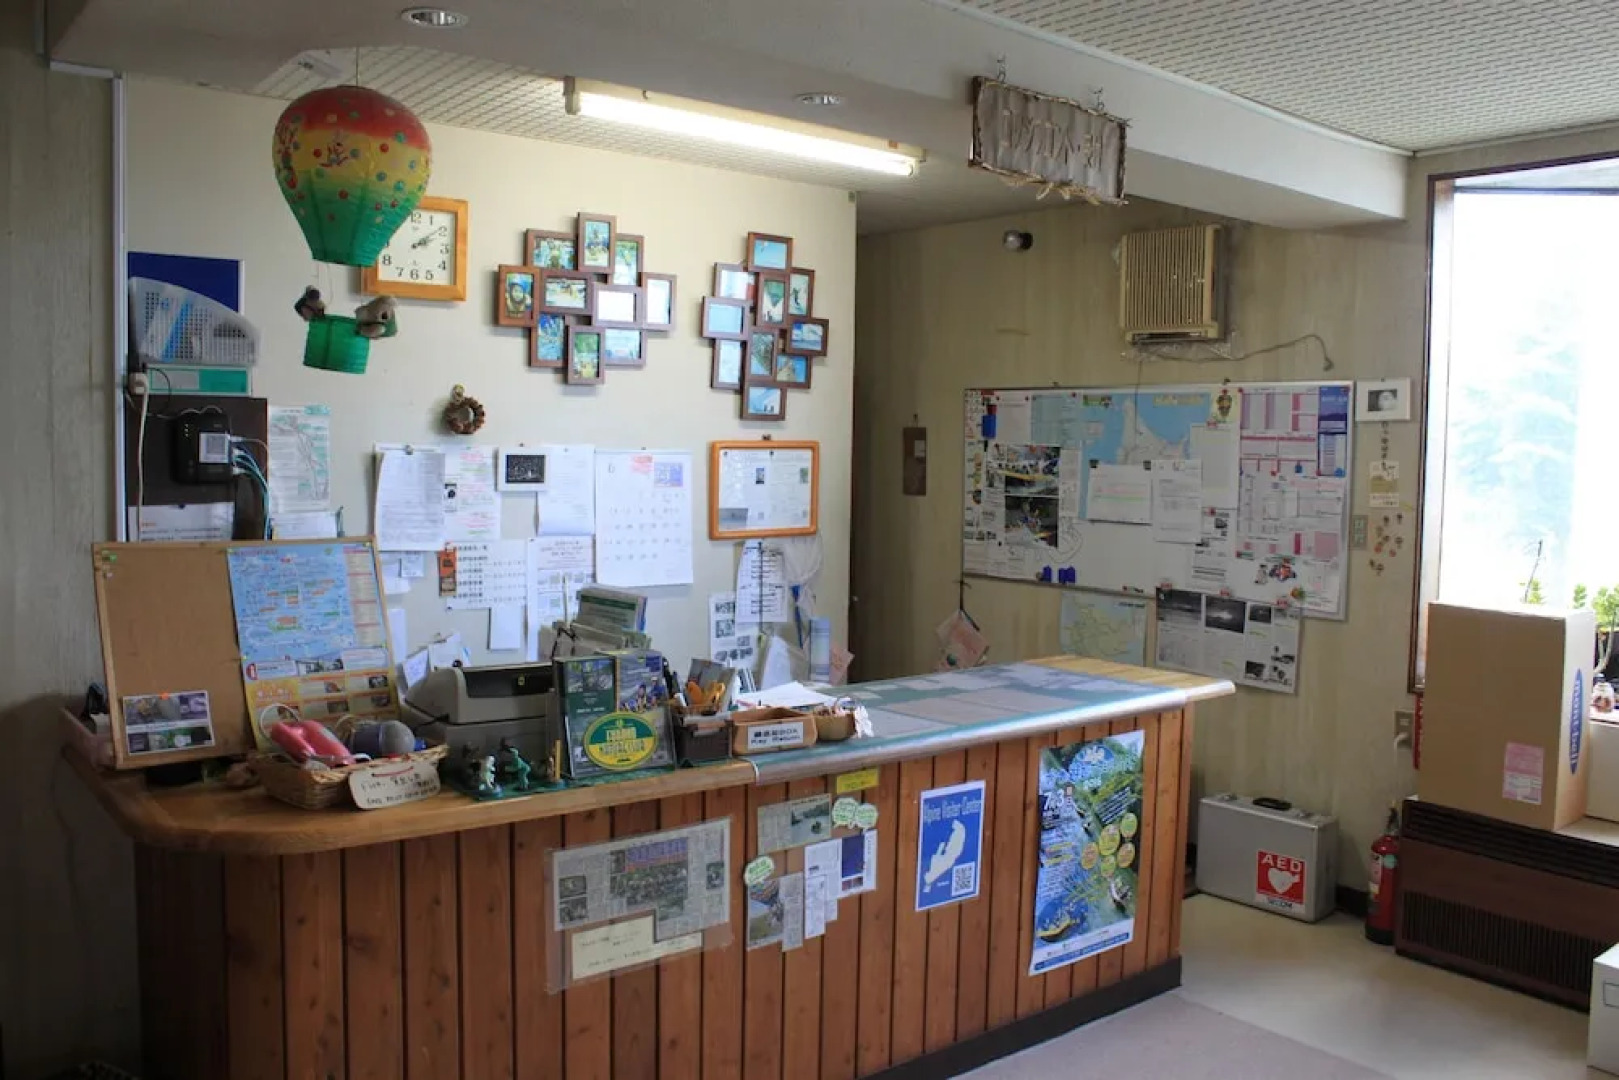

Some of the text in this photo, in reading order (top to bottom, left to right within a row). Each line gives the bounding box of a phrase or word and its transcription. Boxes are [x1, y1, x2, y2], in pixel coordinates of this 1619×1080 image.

[438, 225, 448, 237] 2
[440, 243, 450, 254] 3
[382, 253, 392, 266] 8
[437, 260, 446, 271] 4
[395, 266, 404, 278] 7
[410, 268, 419, 280] 6
[425, 269, 435, 280] 5
[1262, 854, 1301, 872] AED
